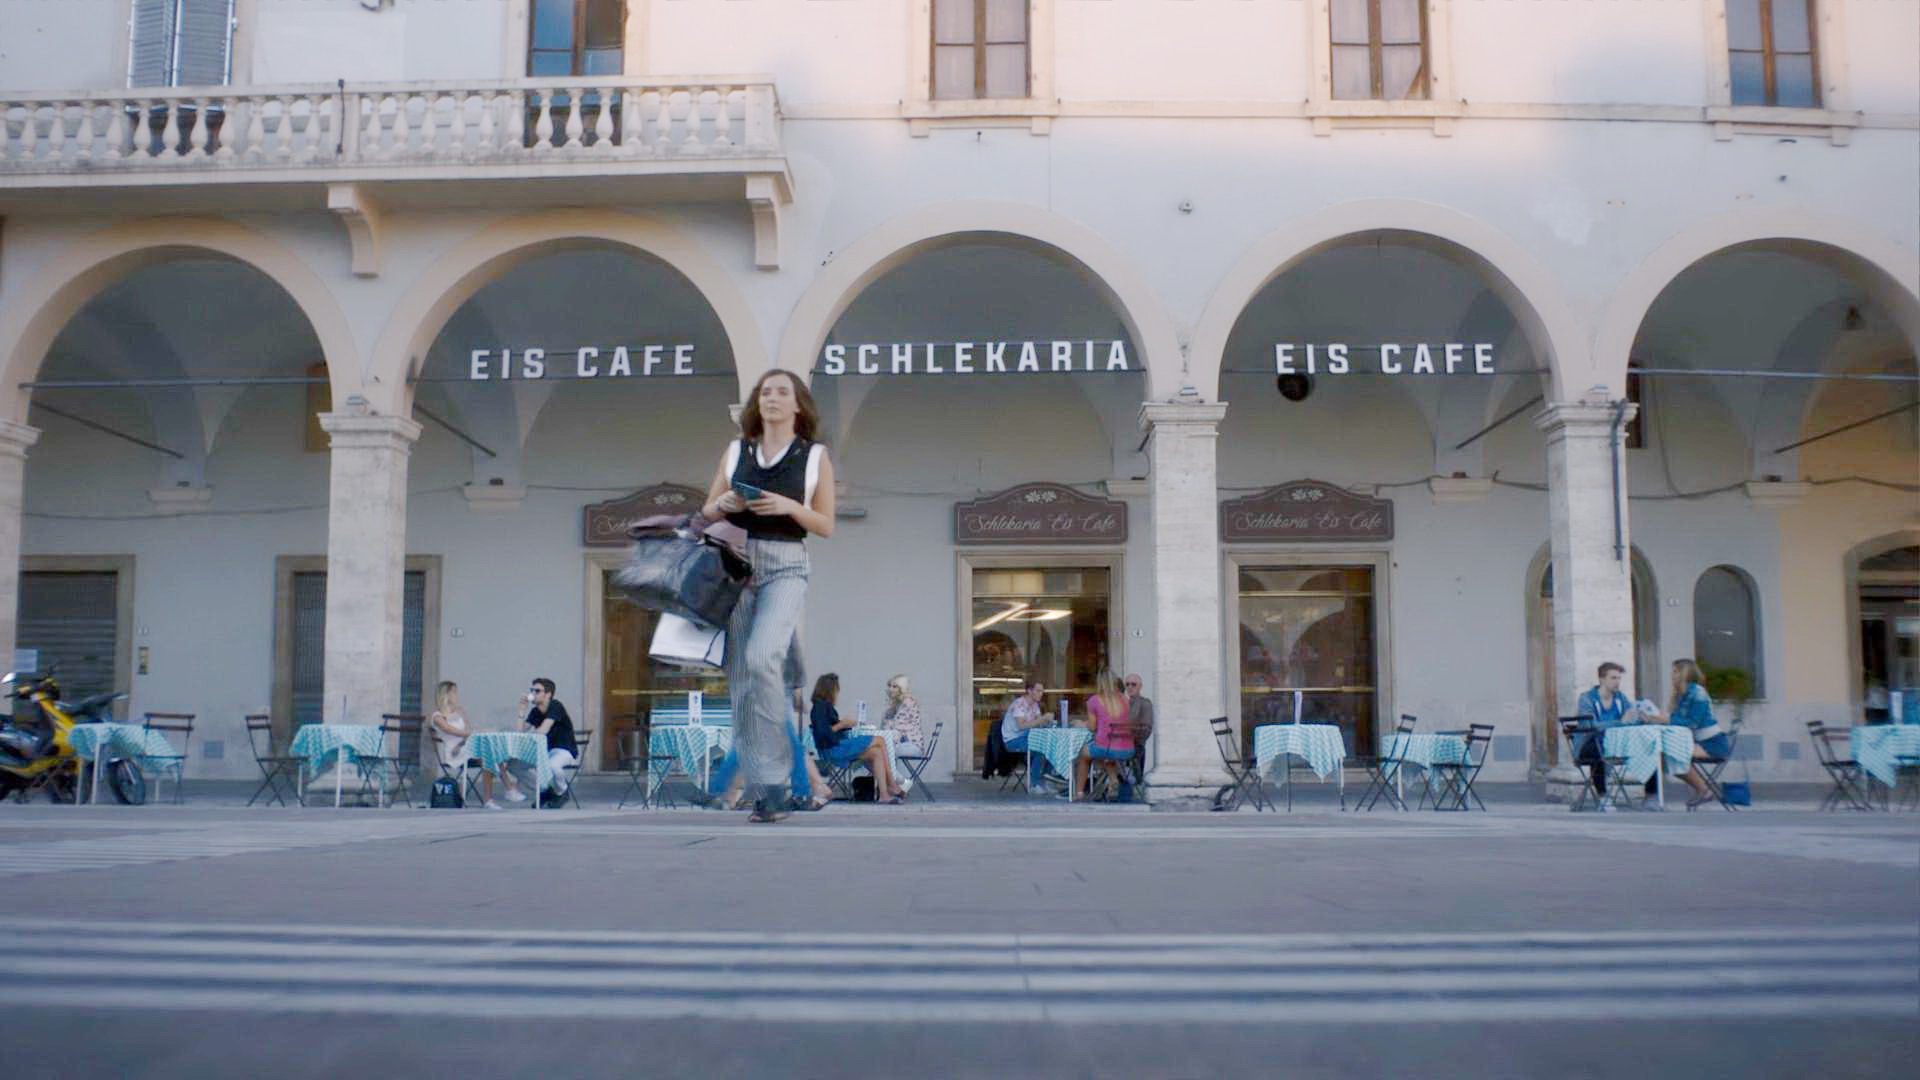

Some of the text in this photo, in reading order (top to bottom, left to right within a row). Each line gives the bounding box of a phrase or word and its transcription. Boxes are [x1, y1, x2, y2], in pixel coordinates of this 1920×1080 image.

[470, 344, 694, 380] EIS CAFE
[824, 340, 1128, 375] SCHLEKARIA
[1275, 343, 1495, 375] EIS CAFE
[965, 511, 1041, 533] Schlekaria
[1048, 511, 1073, 530] Eis
[1231, 511, 1309, 532] Schlekaria
[1315, 511, 1340, 530] Eis
